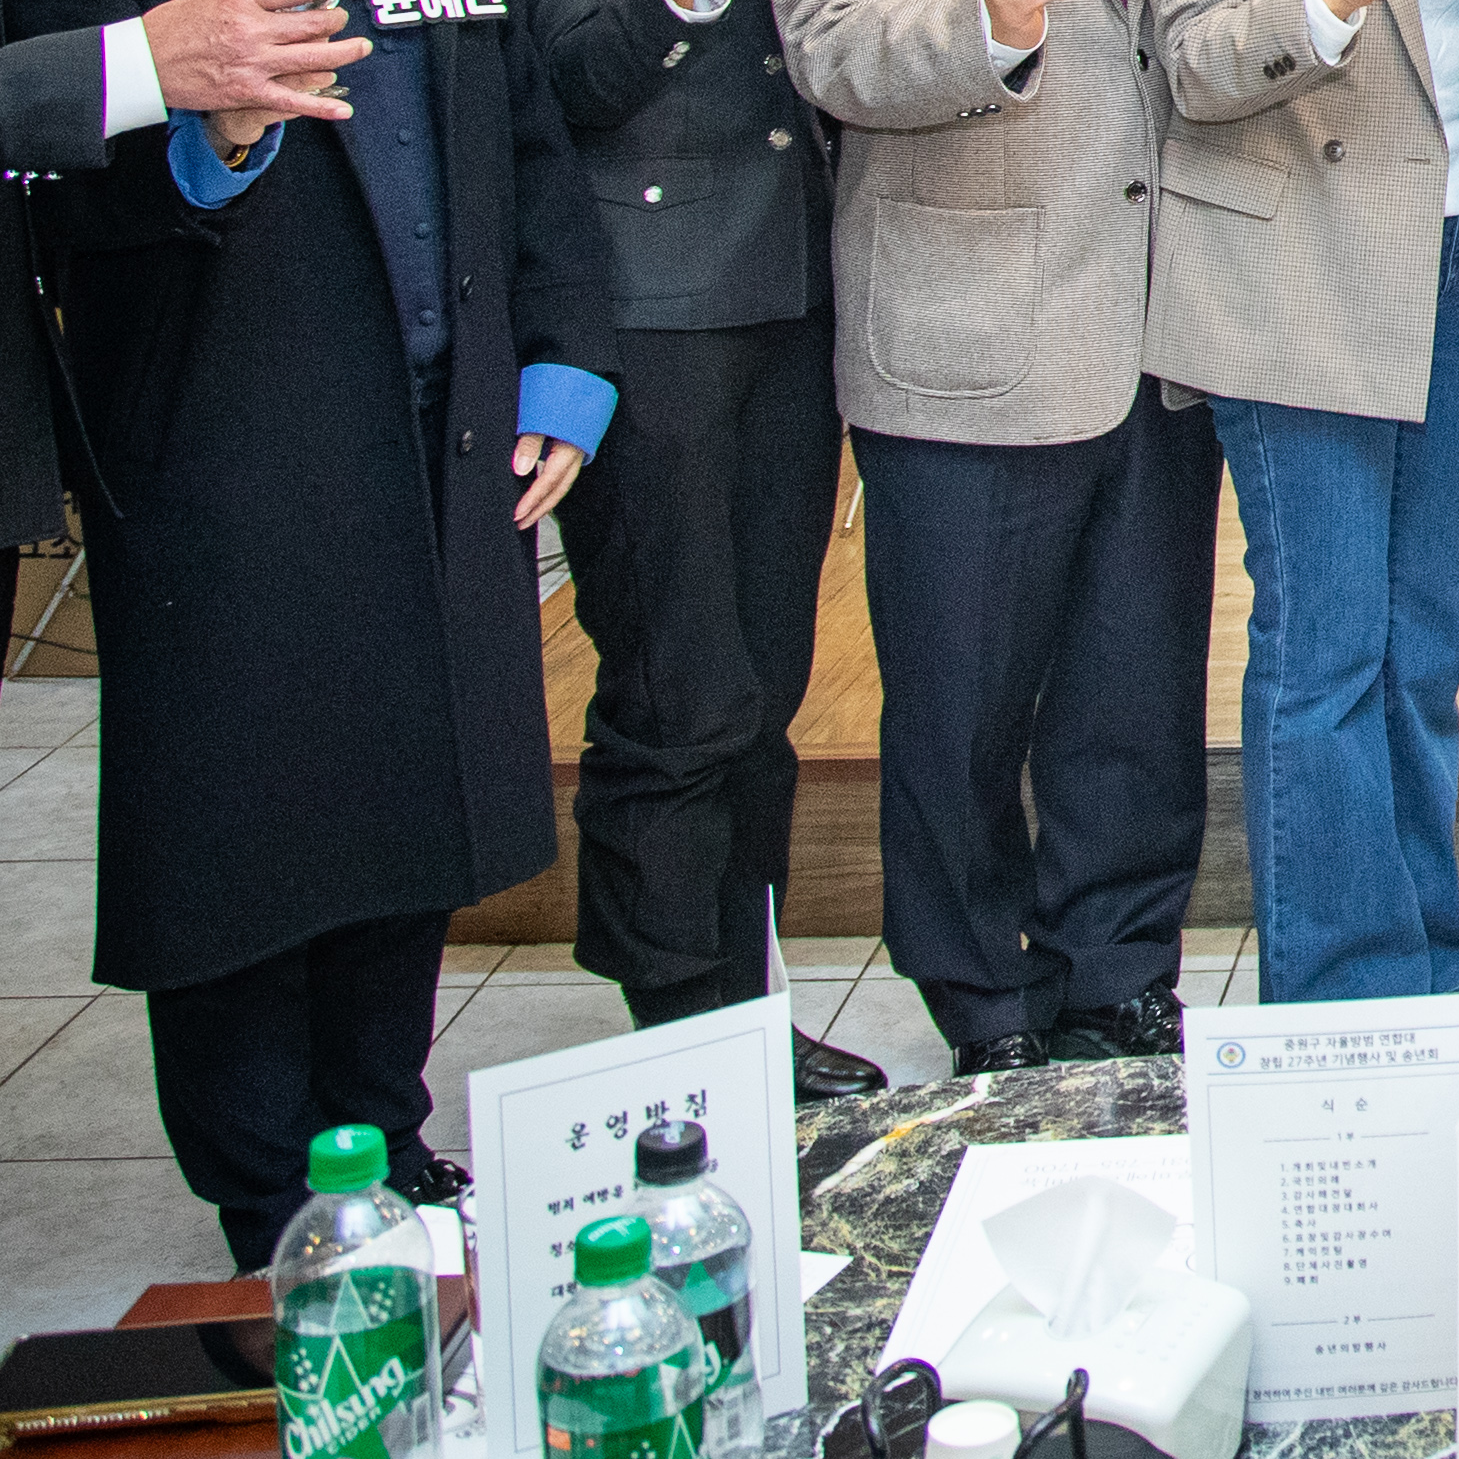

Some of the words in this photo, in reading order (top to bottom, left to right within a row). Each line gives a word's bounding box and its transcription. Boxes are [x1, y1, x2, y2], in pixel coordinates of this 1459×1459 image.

[1379, 1032, 1416, 1046] 연합대
[1287, 1054, 1328, 1068] 27주년
[1332, 1051, 1381, 1066] 기념행사
[1385, 1050, 1397, 1063] 및
[1402, 1048, 1439, 1063] 송년회
[285, 1355, 405, 1459] Chilsung
